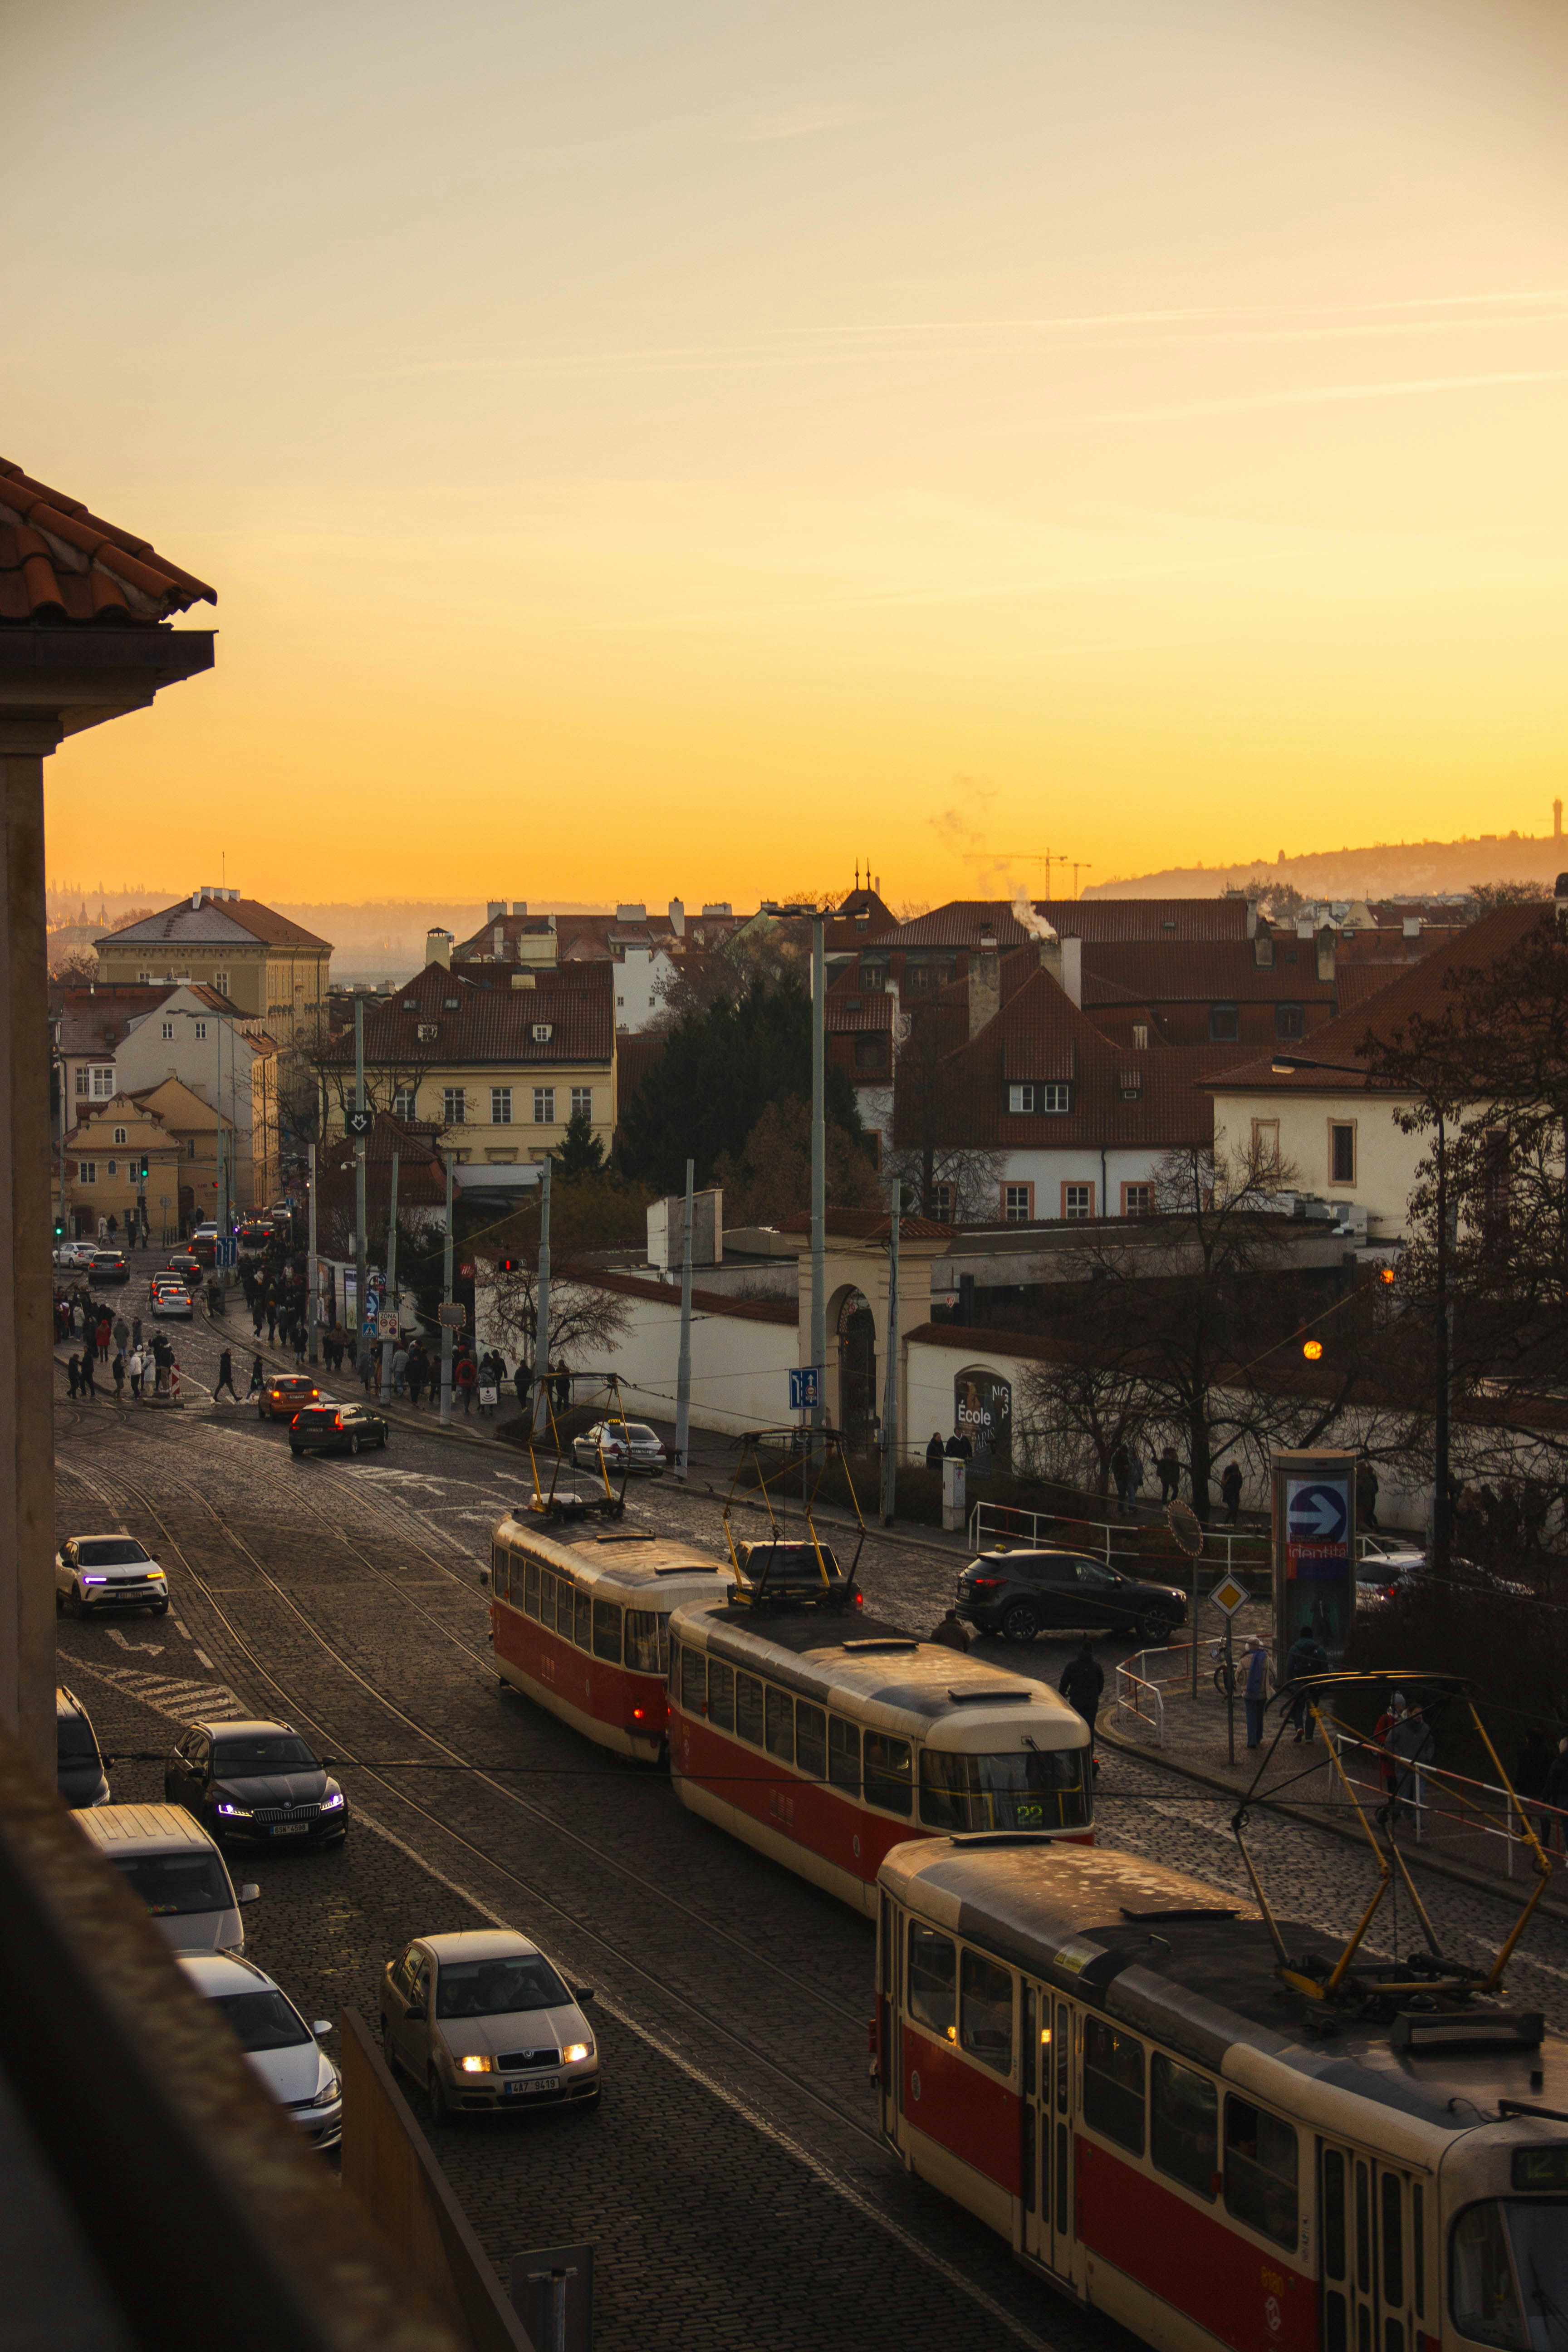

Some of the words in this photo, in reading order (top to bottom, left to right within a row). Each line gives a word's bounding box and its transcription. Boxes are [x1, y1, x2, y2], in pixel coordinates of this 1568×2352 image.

[958, 1399, 991, 1426] École
[972, 1427, 995, 1452] PARIS
[1017, 1805, 1043, 1825] 22
[514, 2082, 528, 2092] 4A7
[535, 2079, 555, 2090] 9419
